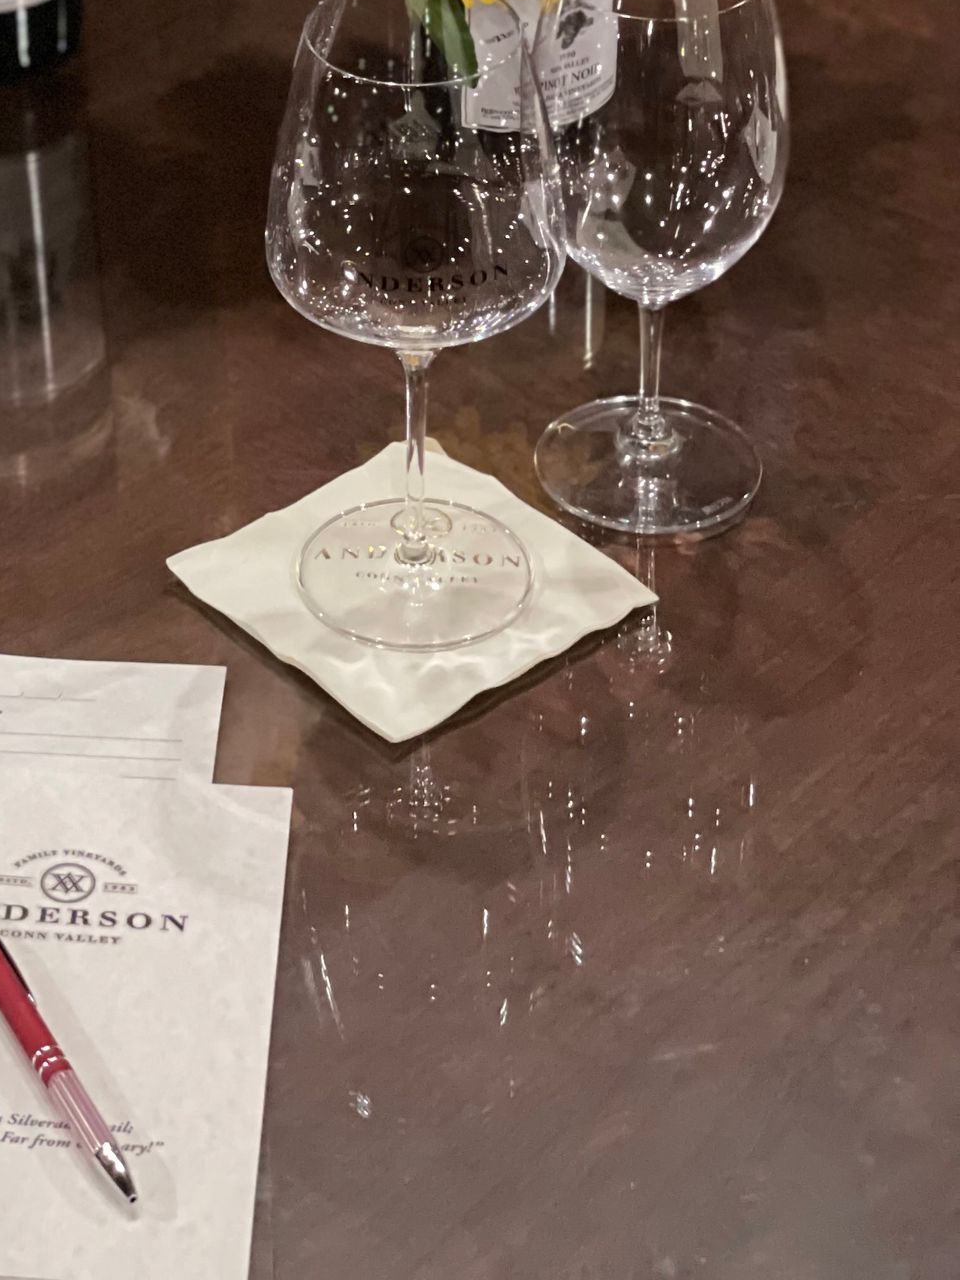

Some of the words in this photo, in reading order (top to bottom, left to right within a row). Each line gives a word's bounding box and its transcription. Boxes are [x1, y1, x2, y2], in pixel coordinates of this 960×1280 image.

[357, 263, 509, 293] NDERSON
[314, 546, 521, 568] ANDSON
[13, 849, 58, 869] FAMILY
[63, 848, 128, 877] VINEYARDS
[0, 928, 48, 941] CONN
[54, 932, 123, 945] VALLEY
[7, 1112, 71, 1130] Silvera
[0, 1130, 29, 1145] Far
[28, 1133, 72, 1150] from
